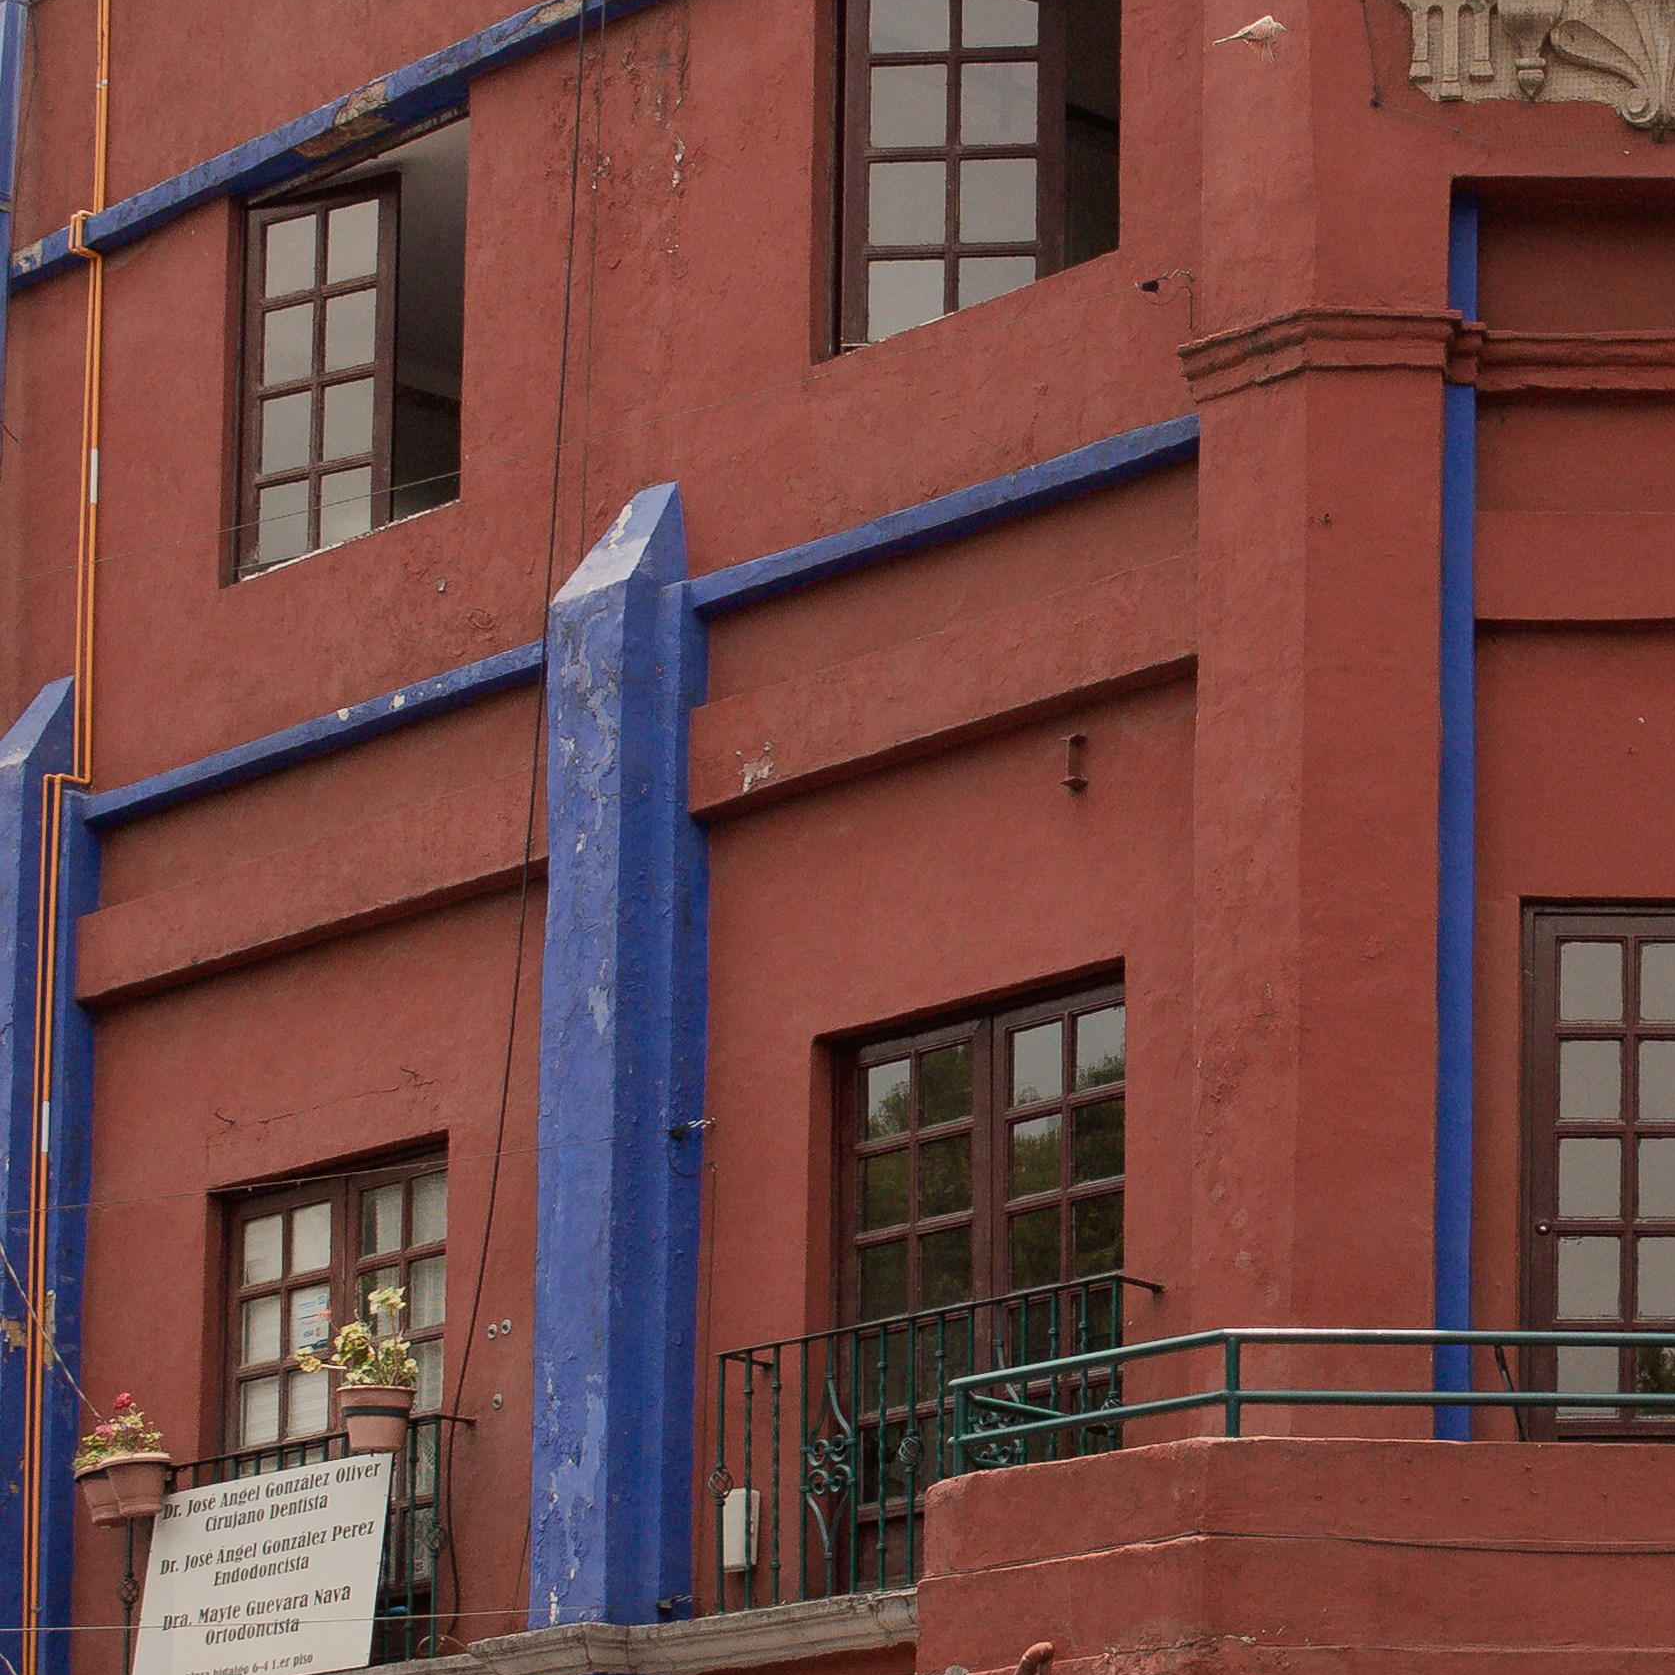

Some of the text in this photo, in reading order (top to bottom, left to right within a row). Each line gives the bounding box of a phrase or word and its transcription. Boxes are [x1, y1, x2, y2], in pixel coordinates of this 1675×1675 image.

[162, 1502, 182, 1521] Dr.
[186, 1495, 216, 1517] José
[265, 1469, 330, 1500] González
[335, 1460, 382, 1485] Oliver
[204, 1493, 329, 1533] Cirujano Dentista
[160, 1558, 180, 1576] Dr.
[183, 1548, 214, 1574] José
[215, 1540, 258, 1566] Ángel
[262, 1529, 327, 1556] González
[213, 1554, 310, 1587] Endodoncista
[161, 1584, 351, 1632] Dra. Mayte Guevara Nava
[293, 1652, 314, 1667] piso
